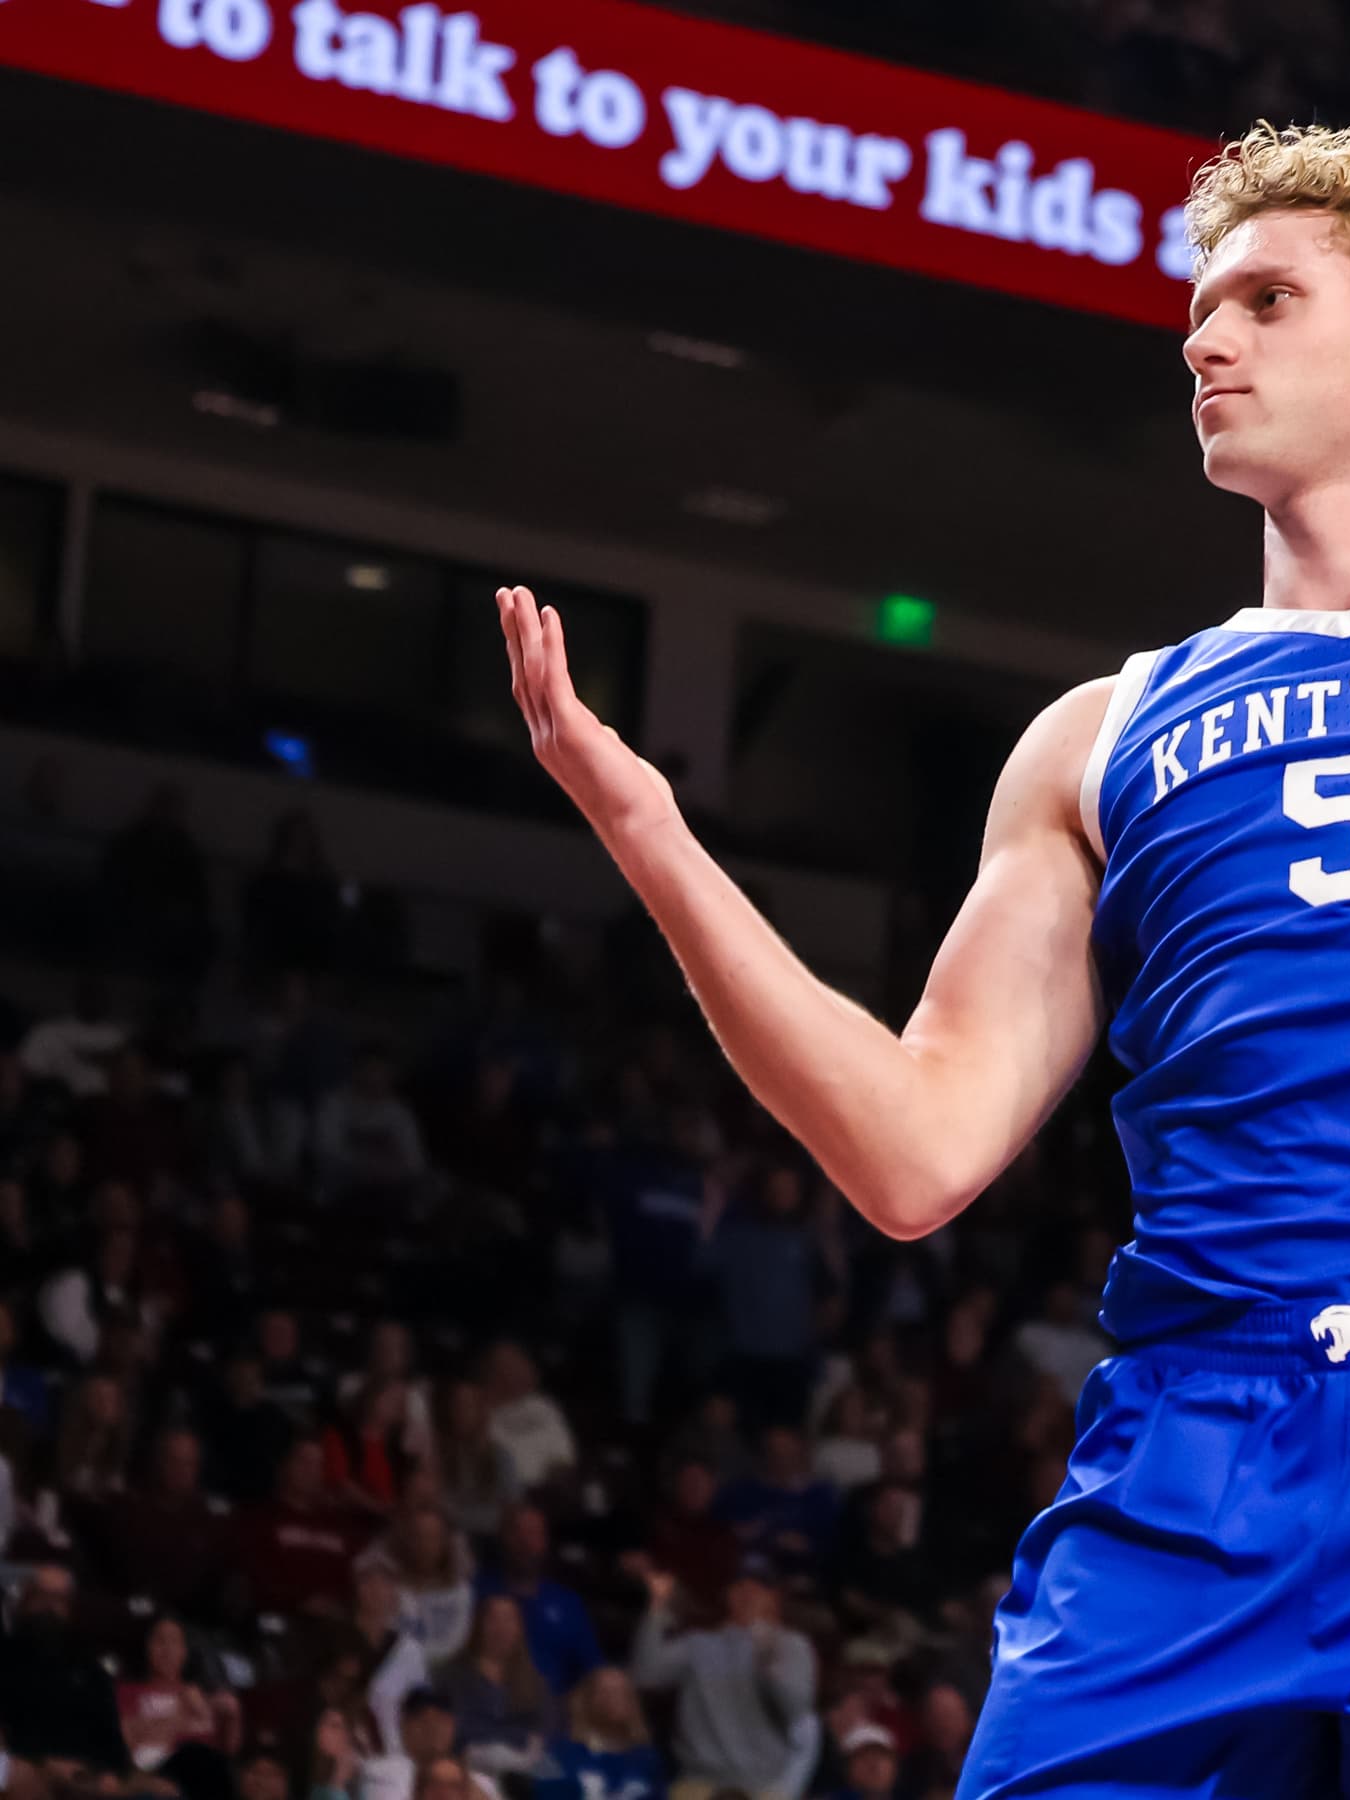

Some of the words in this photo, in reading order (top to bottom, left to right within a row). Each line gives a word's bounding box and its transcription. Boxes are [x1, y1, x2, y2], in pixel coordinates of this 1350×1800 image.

[293, 0, 514, 121] talk
[533, 48, 645, 148] to
[660, 87, 911, 209] your
[921, 128, 1142, 265] kids
